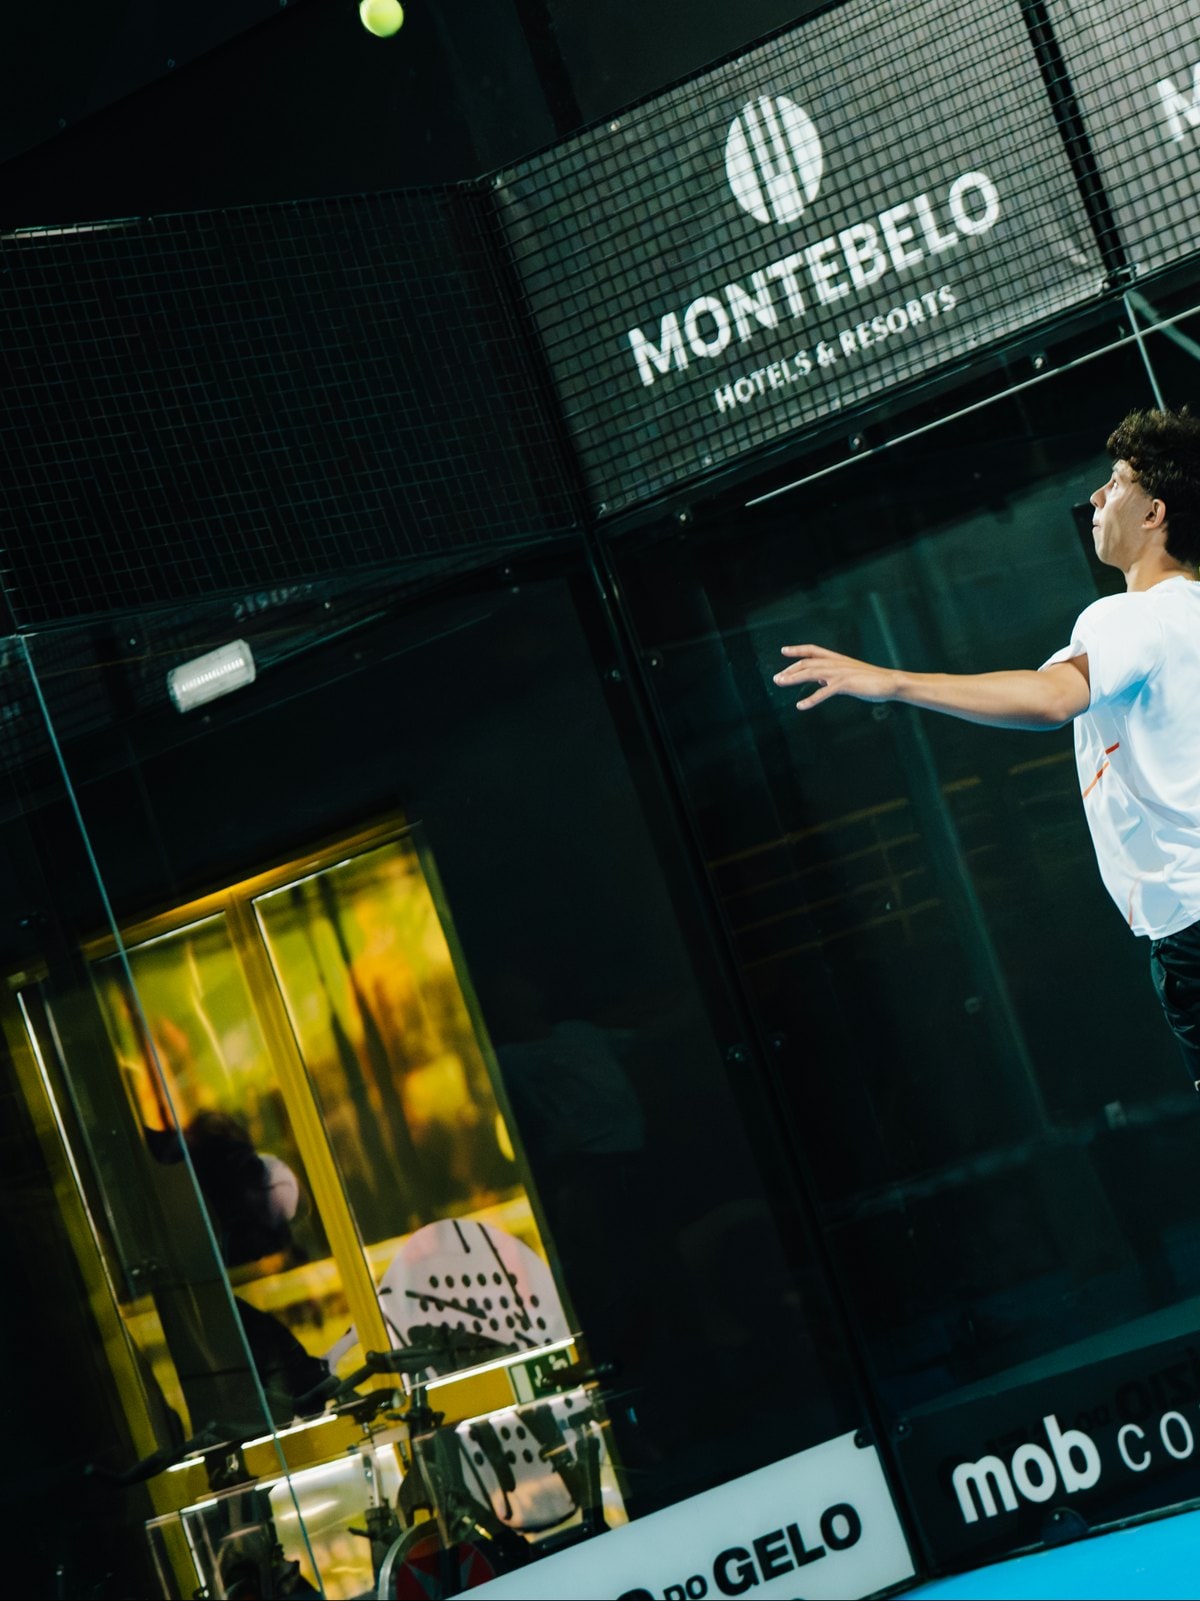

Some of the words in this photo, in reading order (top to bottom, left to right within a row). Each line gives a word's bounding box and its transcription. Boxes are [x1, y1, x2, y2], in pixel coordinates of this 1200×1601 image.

[627, 171, 1001, 386] MONTEBELO
[714, 348, 812, 414] HOTELS
[816, 340, 836, 367] &
[841, 285, 957, 358] RESORTS
[952, 1414, 1101, 1524] mob
[663, 1574, 708, 1600] DO
[713, 1503, 862, 1597] GELO
